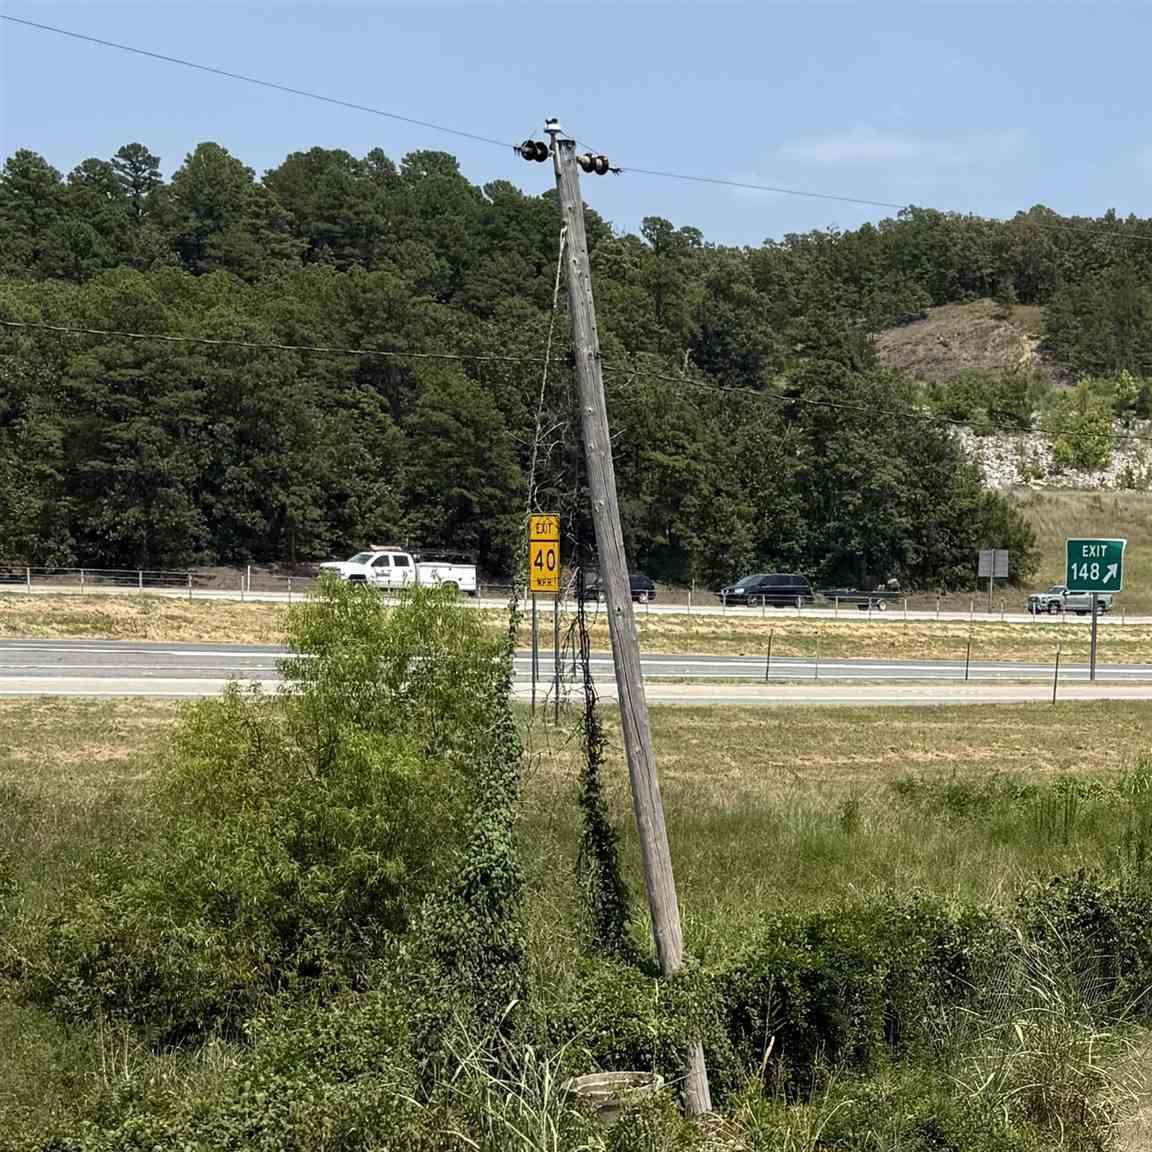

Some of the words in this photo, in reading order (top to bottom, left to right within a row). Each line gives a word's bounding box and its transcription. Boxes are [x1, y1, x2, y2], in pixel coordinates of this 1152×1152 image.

[536, 522, 552, 534] EXIT
[1082, 545, 1108, 557] EXIT
[534, 549, 556, 571] 40
[1071, 562, 1100, 580] 148
